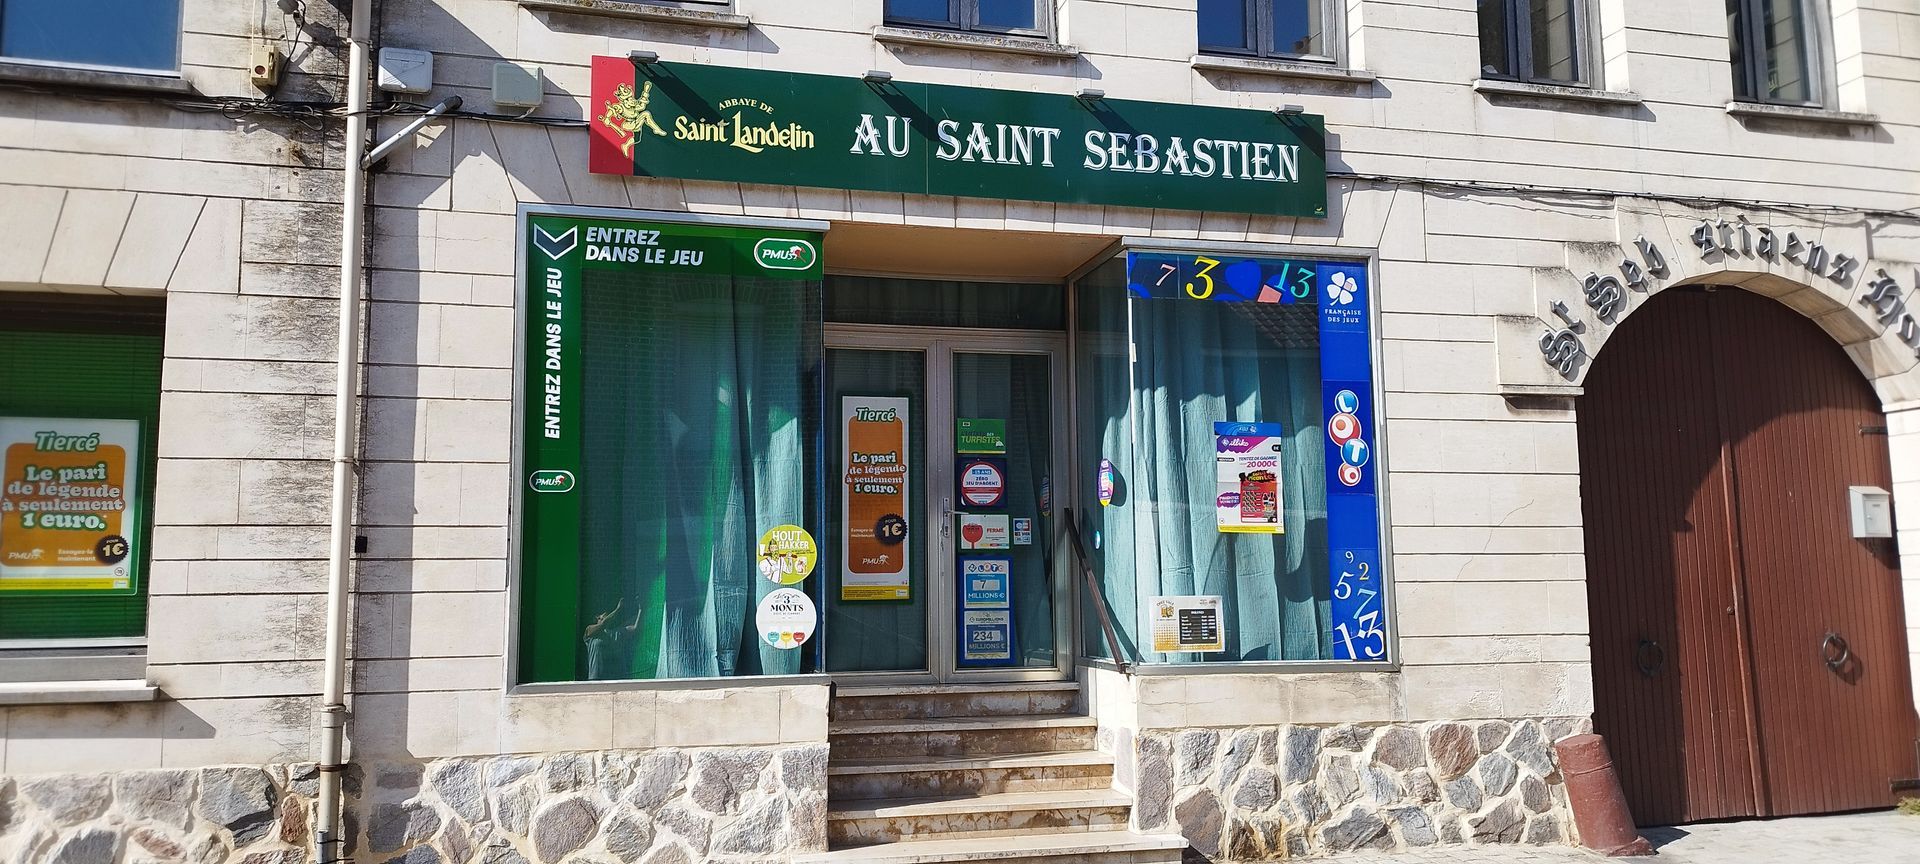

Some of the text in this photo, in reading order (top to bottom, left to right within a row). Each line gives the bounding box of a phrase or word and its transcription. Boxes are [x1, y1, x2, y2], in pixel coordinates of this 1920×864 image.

[718, 98, 775, 115] ABBAYE DE
[674, 110, 815, 153] Saint Landelin
[849, 113, 1301, 183] AU SAINT SEBASTIEN
[585, 227, 661, 246] ENTREZ
[585, 245, 704, 266] DANS LE JEU
[762, 249, 790, 260] PMU
[1156, 263, 1176, 287] 7
[1185, 255, 1221, 299] 3
[1324, 309, 1361, 317] FRANÇAISE
[545, 267, 563, 439] ENTREZ DANS LE JEU
[857, 408, 896, 421] Tiercé
[35, 431, 100, 452] Tiercé
[853, 452, 896, 464] Le pari
[26, 463, 106, 484] Le pari
[850, 464, 906, 475] de légende
[535, 478, 555, 486] PMU
[854, 475, 904, 483] seulement
[8, 481, 120, 499] de légende
[1, 497, 123, 511] à seulement
[23, 512, 34, 527] 1
[772, 530, 803, 541] HOUT
[883, 523, 902, 537] 1€
[102, 542, 124, 556] 1€
[779, 540, 809, 550] HAKKER
[8, 552, 31, 560] PMU
[1345, 551, 1354, 564] 9
[1359, 562, 1370, 580] 2
[980, 580, 987, 589] 7
[1334, 571, 1355, 600] 5
[783, 596, 791, 604] 3
[1353, 588, 1377, 620] 7
[771, 604, 804, 612] MONTS
[974, 631, 993, 640] 234
